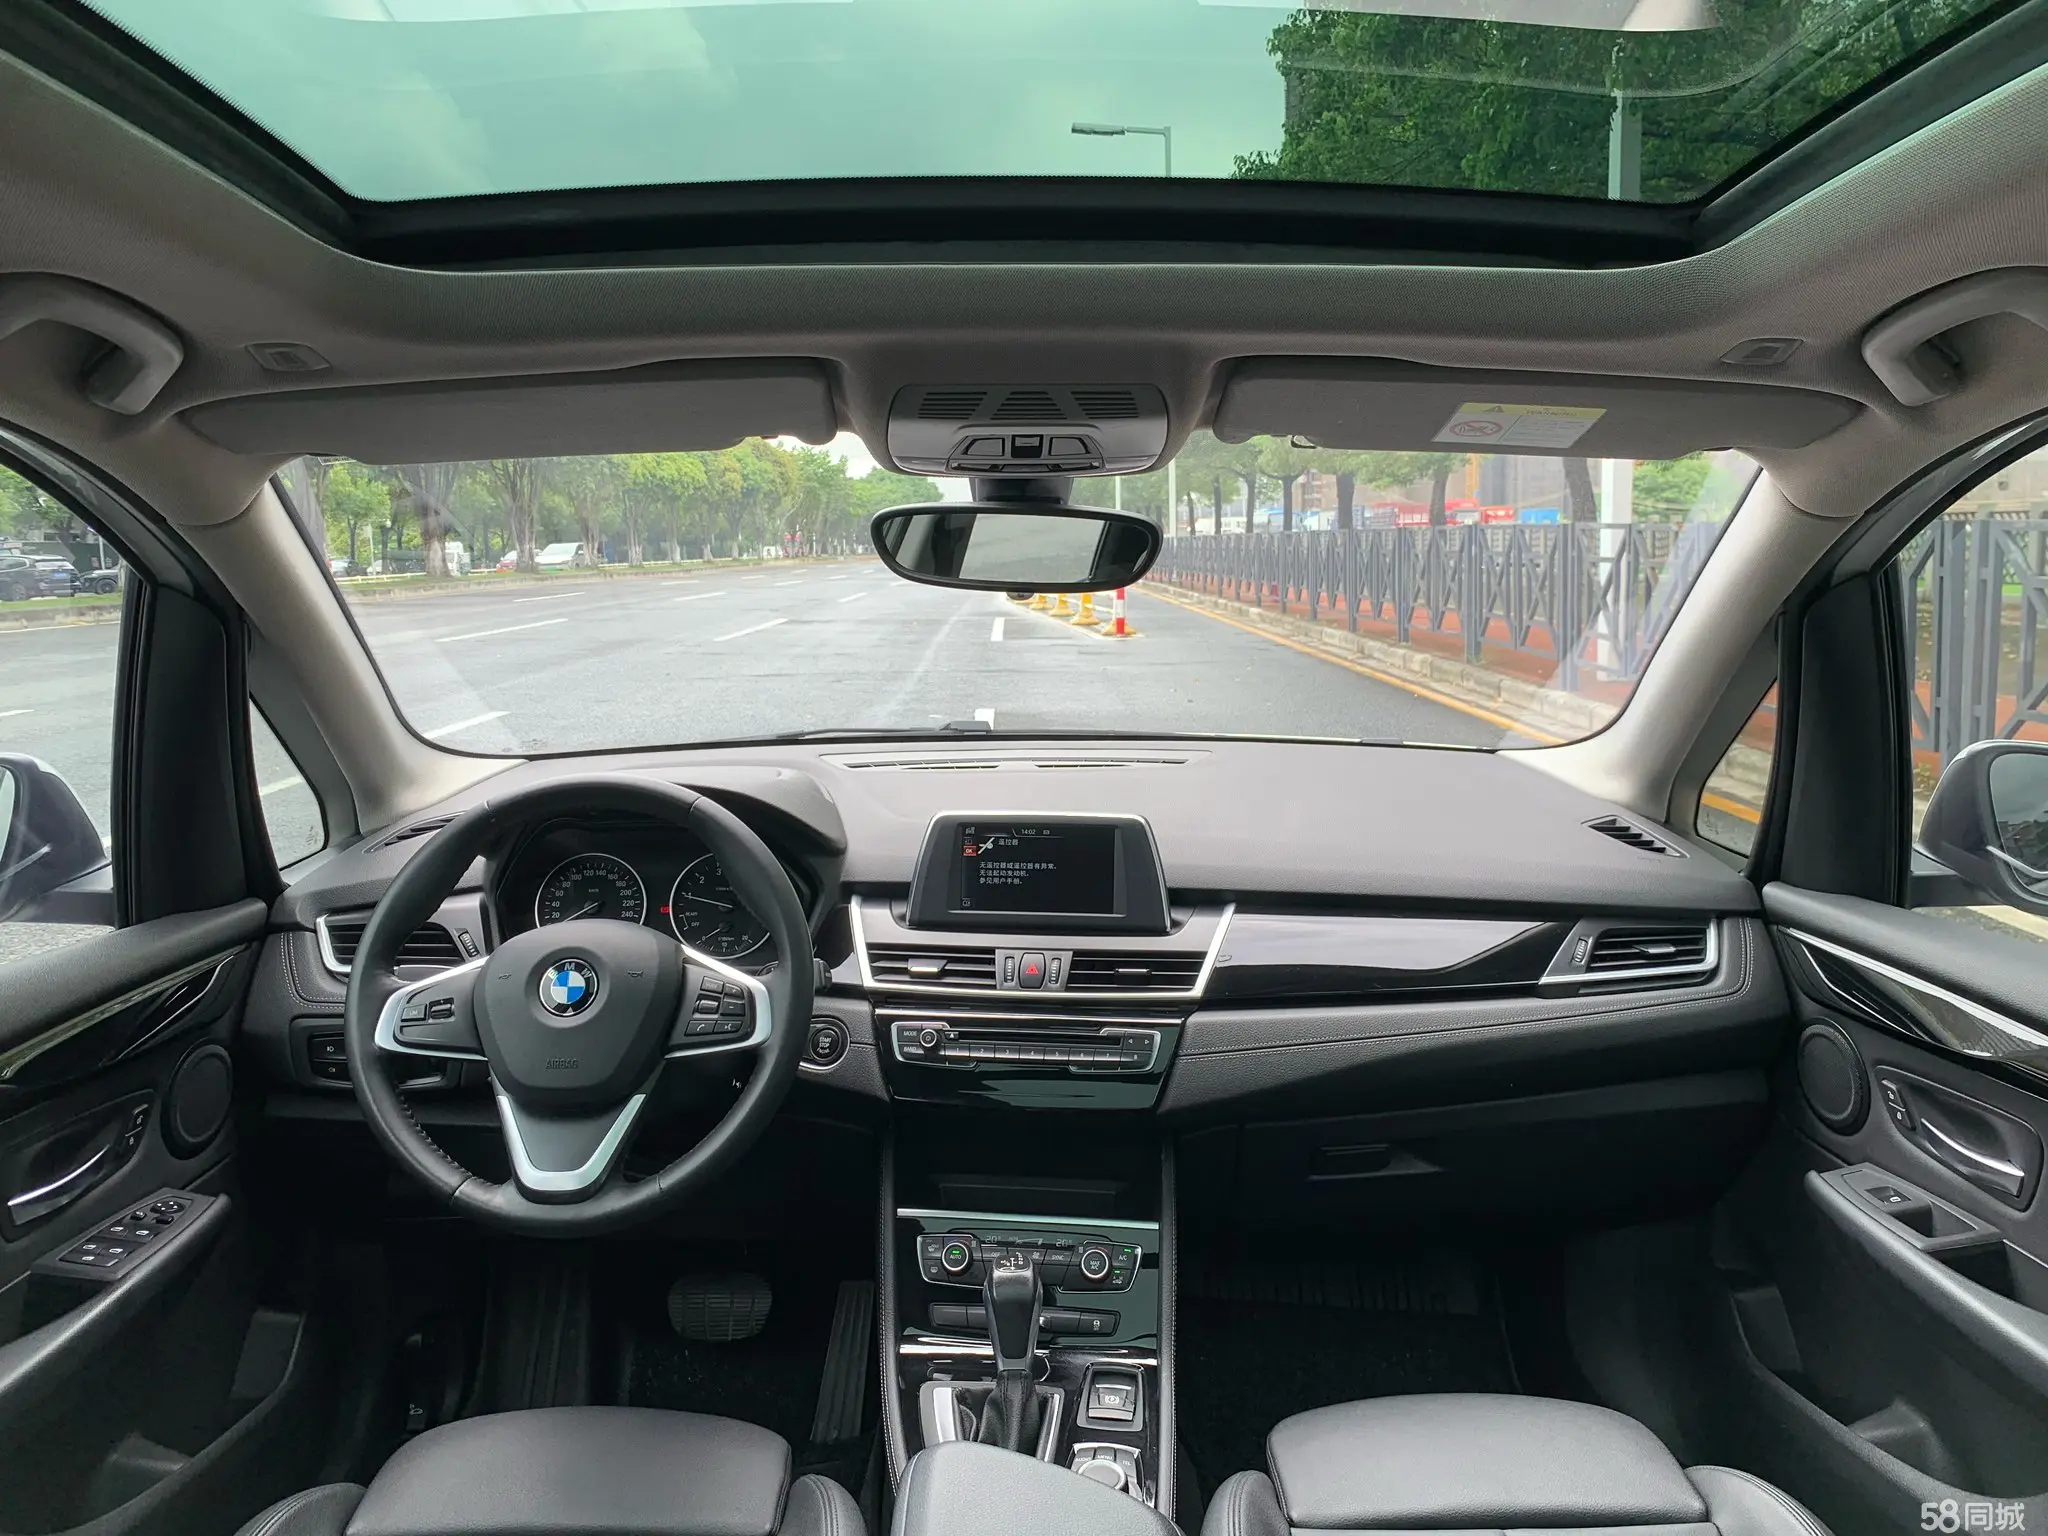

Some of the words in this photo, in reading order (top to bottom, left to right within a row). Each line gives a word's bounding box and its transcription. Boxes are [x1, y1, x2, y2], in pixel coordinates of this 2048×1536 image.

[716, 868, 722, 876] 3
[699, 876, 705, 884] 2
[551, 900, 560, 908] 40
[551, 911, 560, 919] 20
[547, 962, 593, 980] BMW
[545, 1058, 578, 1070] AIRBAG
